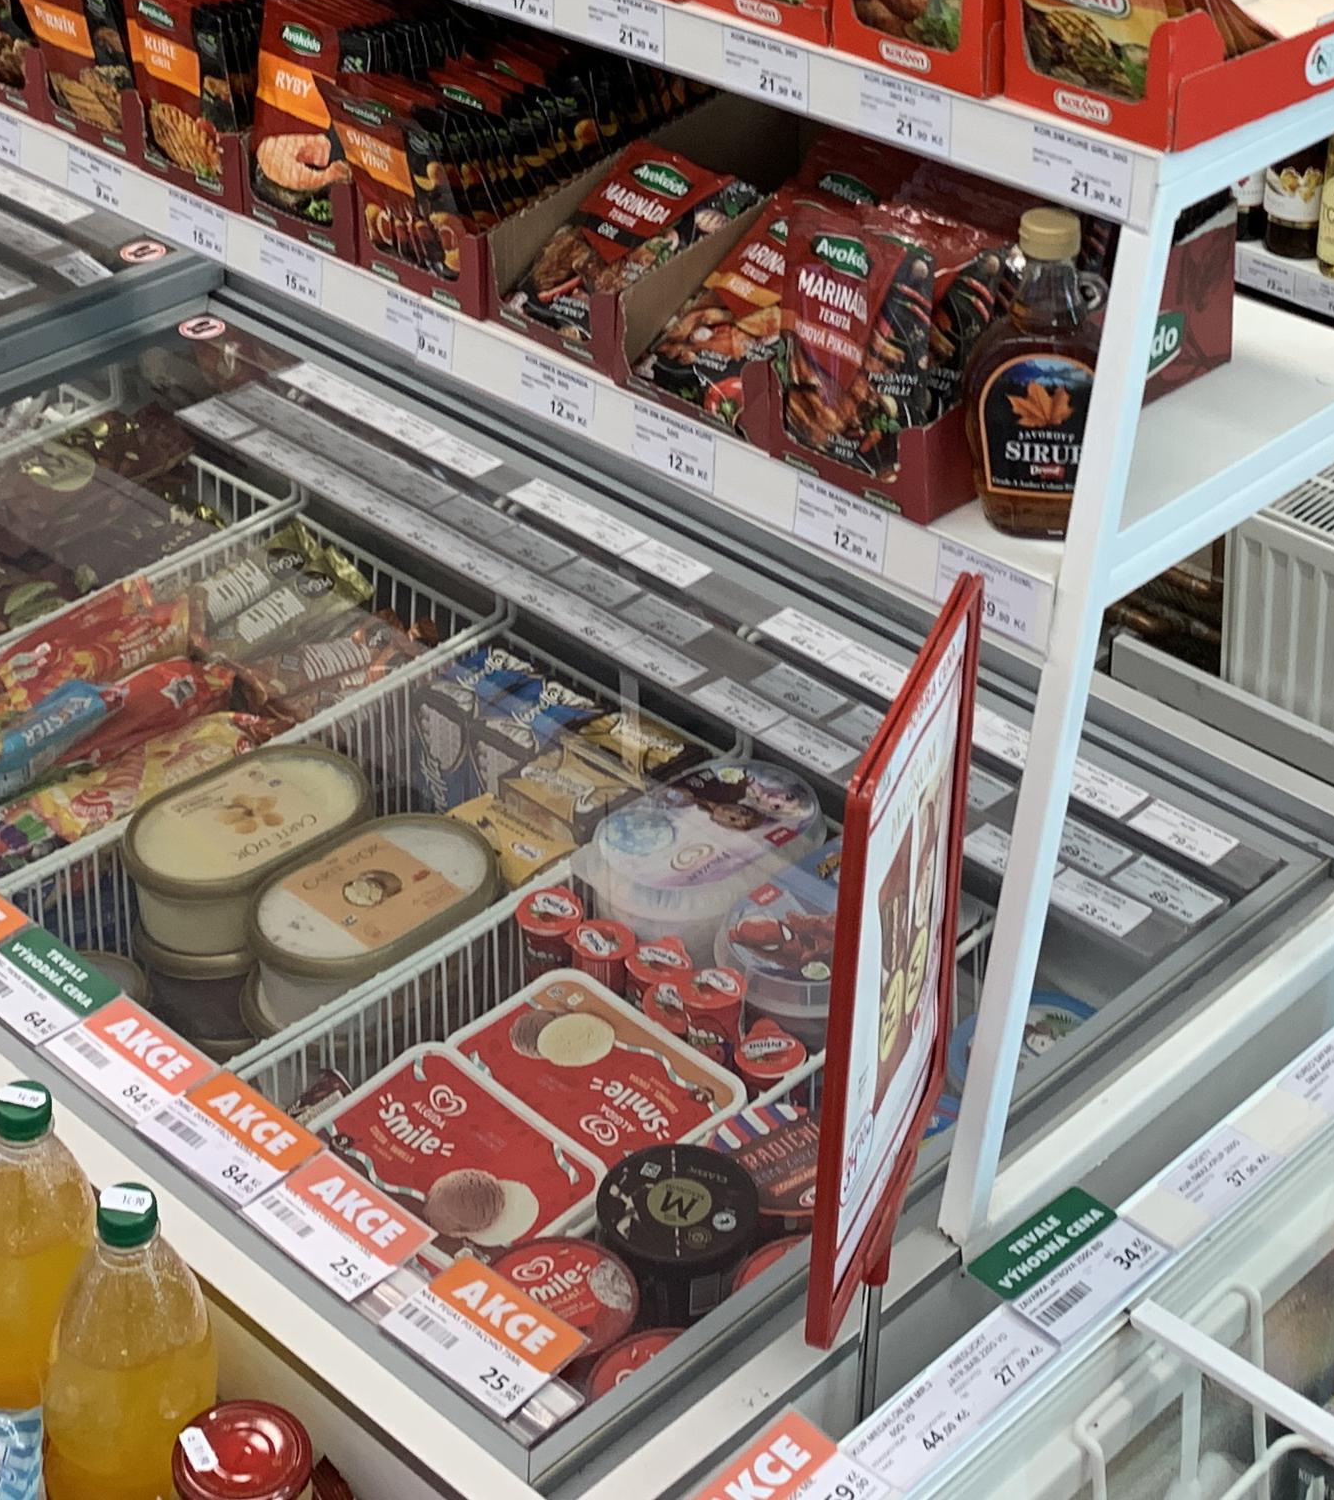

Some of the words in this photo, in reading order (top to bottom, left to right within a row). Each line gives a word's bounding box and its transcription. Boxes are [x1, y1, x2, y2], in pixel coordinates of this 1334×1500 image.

[144, 32, 177, 60] KUŘE
[274, 68, 312, 99] RYBY
[633, 161, 689, 197] Avokádo
[46, 947, 89, 983] TRVALE
[61, 980, 94, 1010] CENA
[103, 1016, 193, 1082] AKCE
[207, 1091, 298, 1157] AKCE
[378, 1100, 441, 1157] Smile
[411, 1100, 448, 1131] ALGIDA
[602, 1079, 671, 1138] Smile
[307, 1175, 407, 1249] AKCE
[1007, 1214, 1062, 1257] TRVALE
[997, 1236, 1072, 1291] VÝHODNÁ
[1066, 1206, 1106, 1245] CENA
[529, 1269, 584, 1303] mile
[451, 1279, 558, 1356] AKCE
[711, 1434, 812, 1499] KCE
